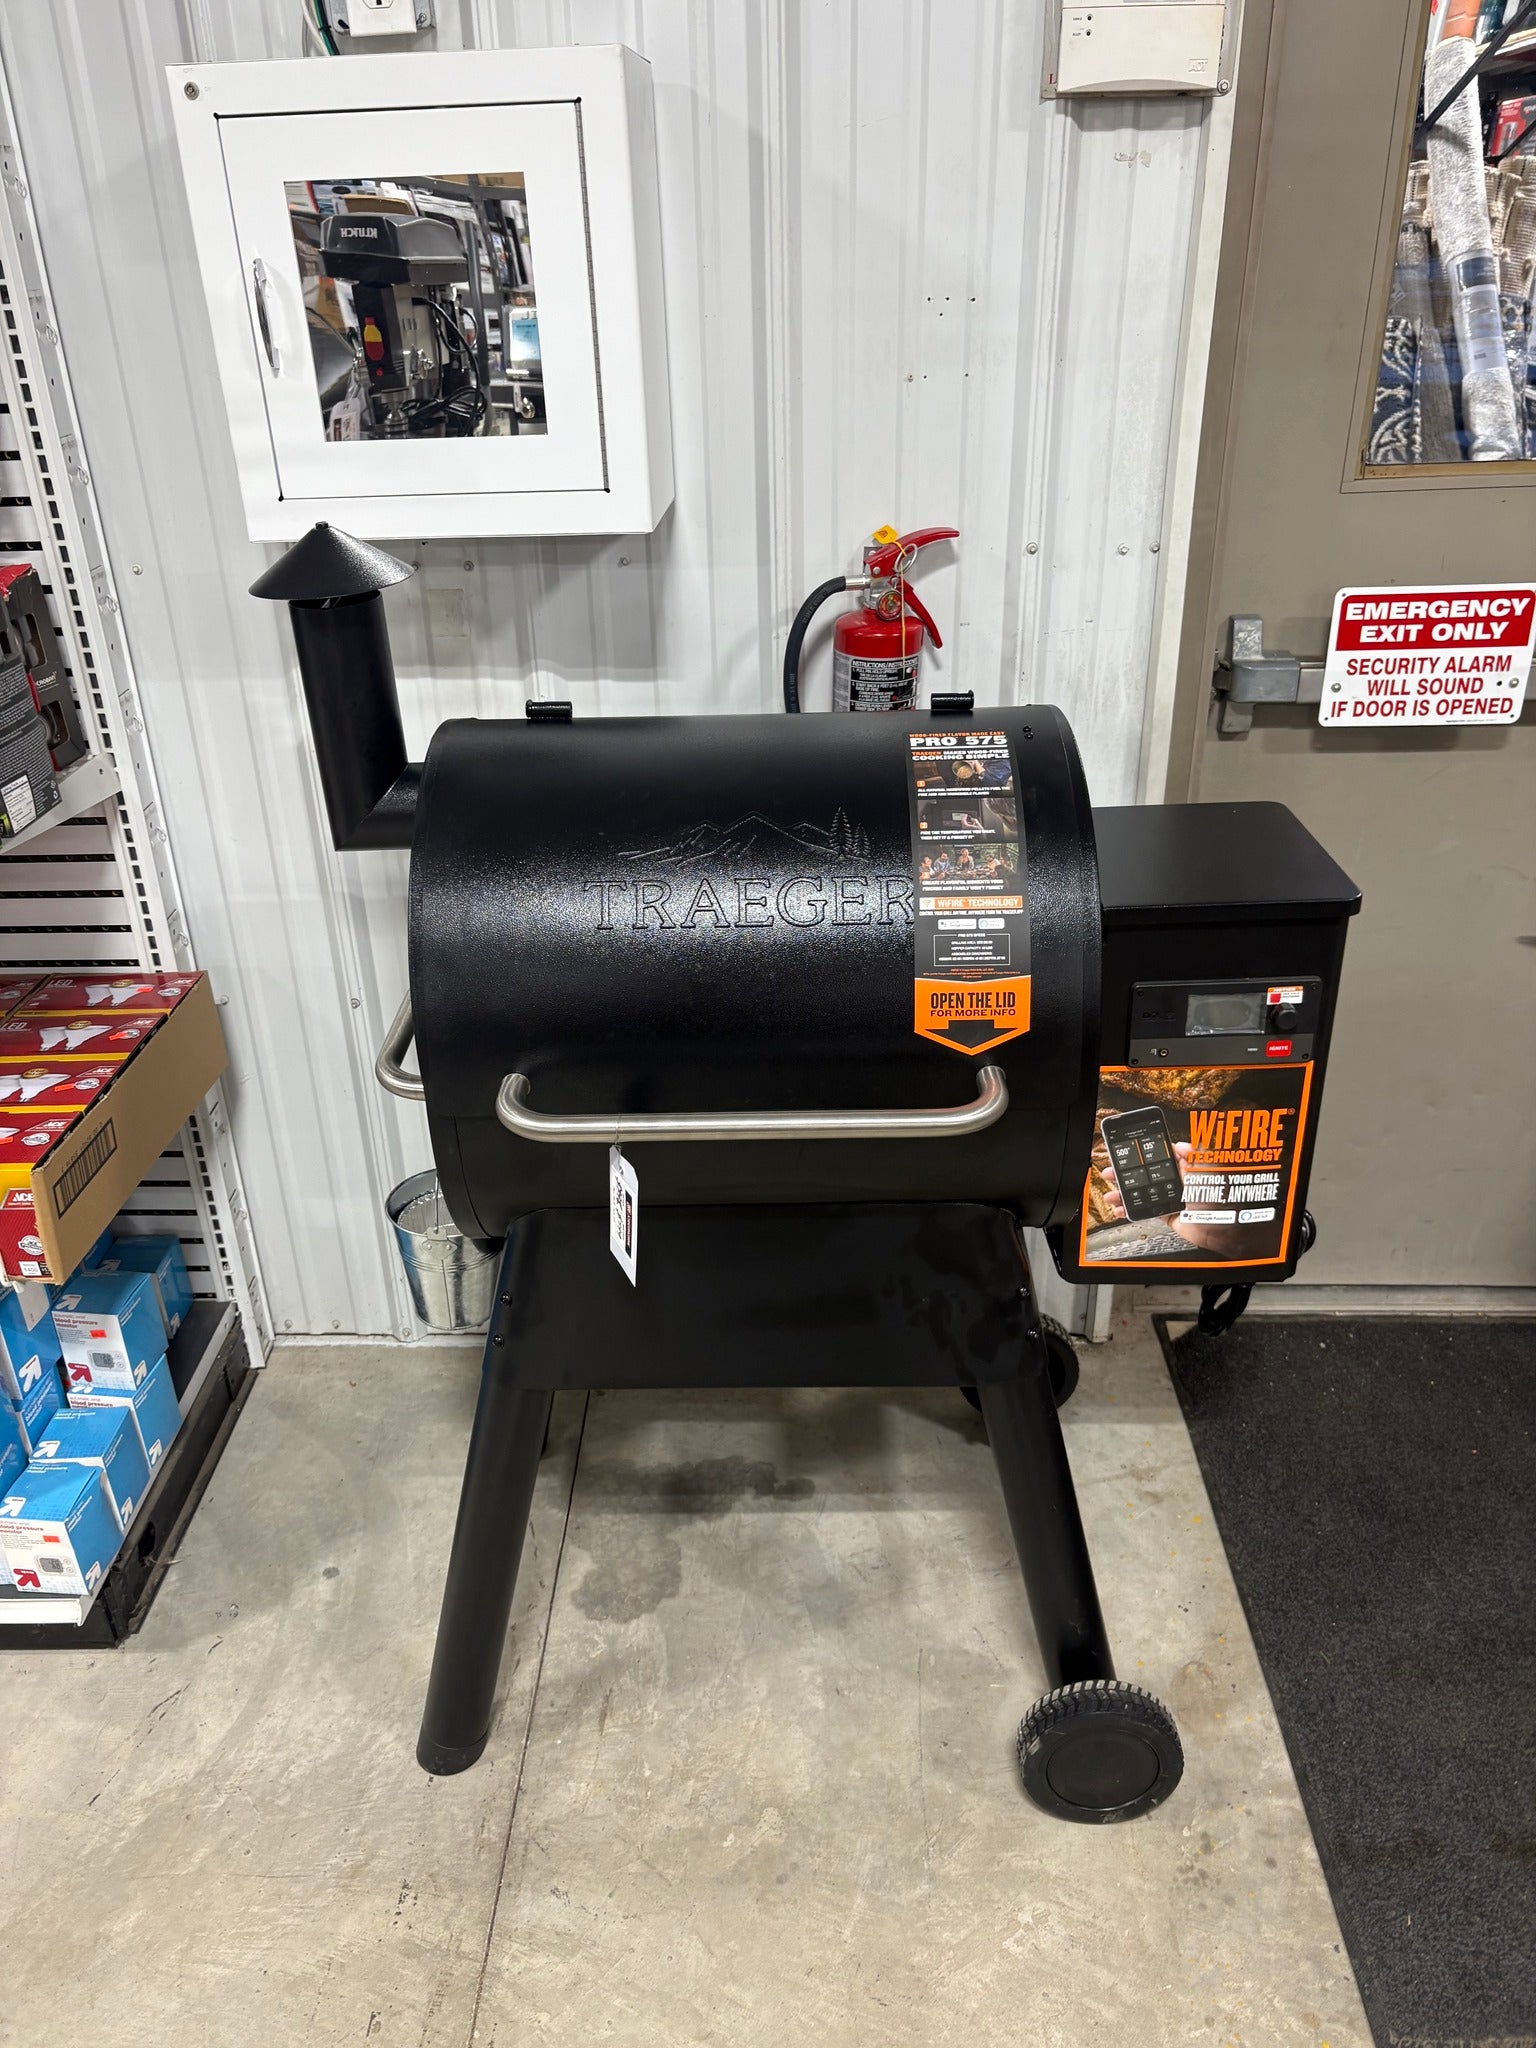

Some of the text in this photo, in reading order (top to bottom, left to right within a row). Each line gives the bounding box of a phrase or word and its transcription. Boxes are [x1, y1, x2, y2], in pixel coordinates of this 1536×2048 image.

[1346, 597, 1531, 621] EMERGENCY
[1360, 622, 1510, 643] EXIT ONLY
[1346, 655, 1512, 676] SECURITY ALARM
[1367, 677, 1484, 696] WILL SOUND
[1330, 698, 1514, 718] IF DOOR IS OPENED
[910, 735, 1007, 746] PRO 575
[584, 876, 914, 930] TRAEGER
[968, 898, 1019, 907] TECHNOLOGY
[931, 992, 1016, 1009] OPEN THE LID
[1190, 1108, 1288, 1149] WiFIRE
[1186, 1148, 1282, 1163] TECHNOLOGY
[1183, 1172, 1280, 1185] CONTROL YOUR GRILL
[12, 1193, 34, 1202] ACE
[1181, 1184, 1279, 1203] ANYTIME, ANYWHERE
